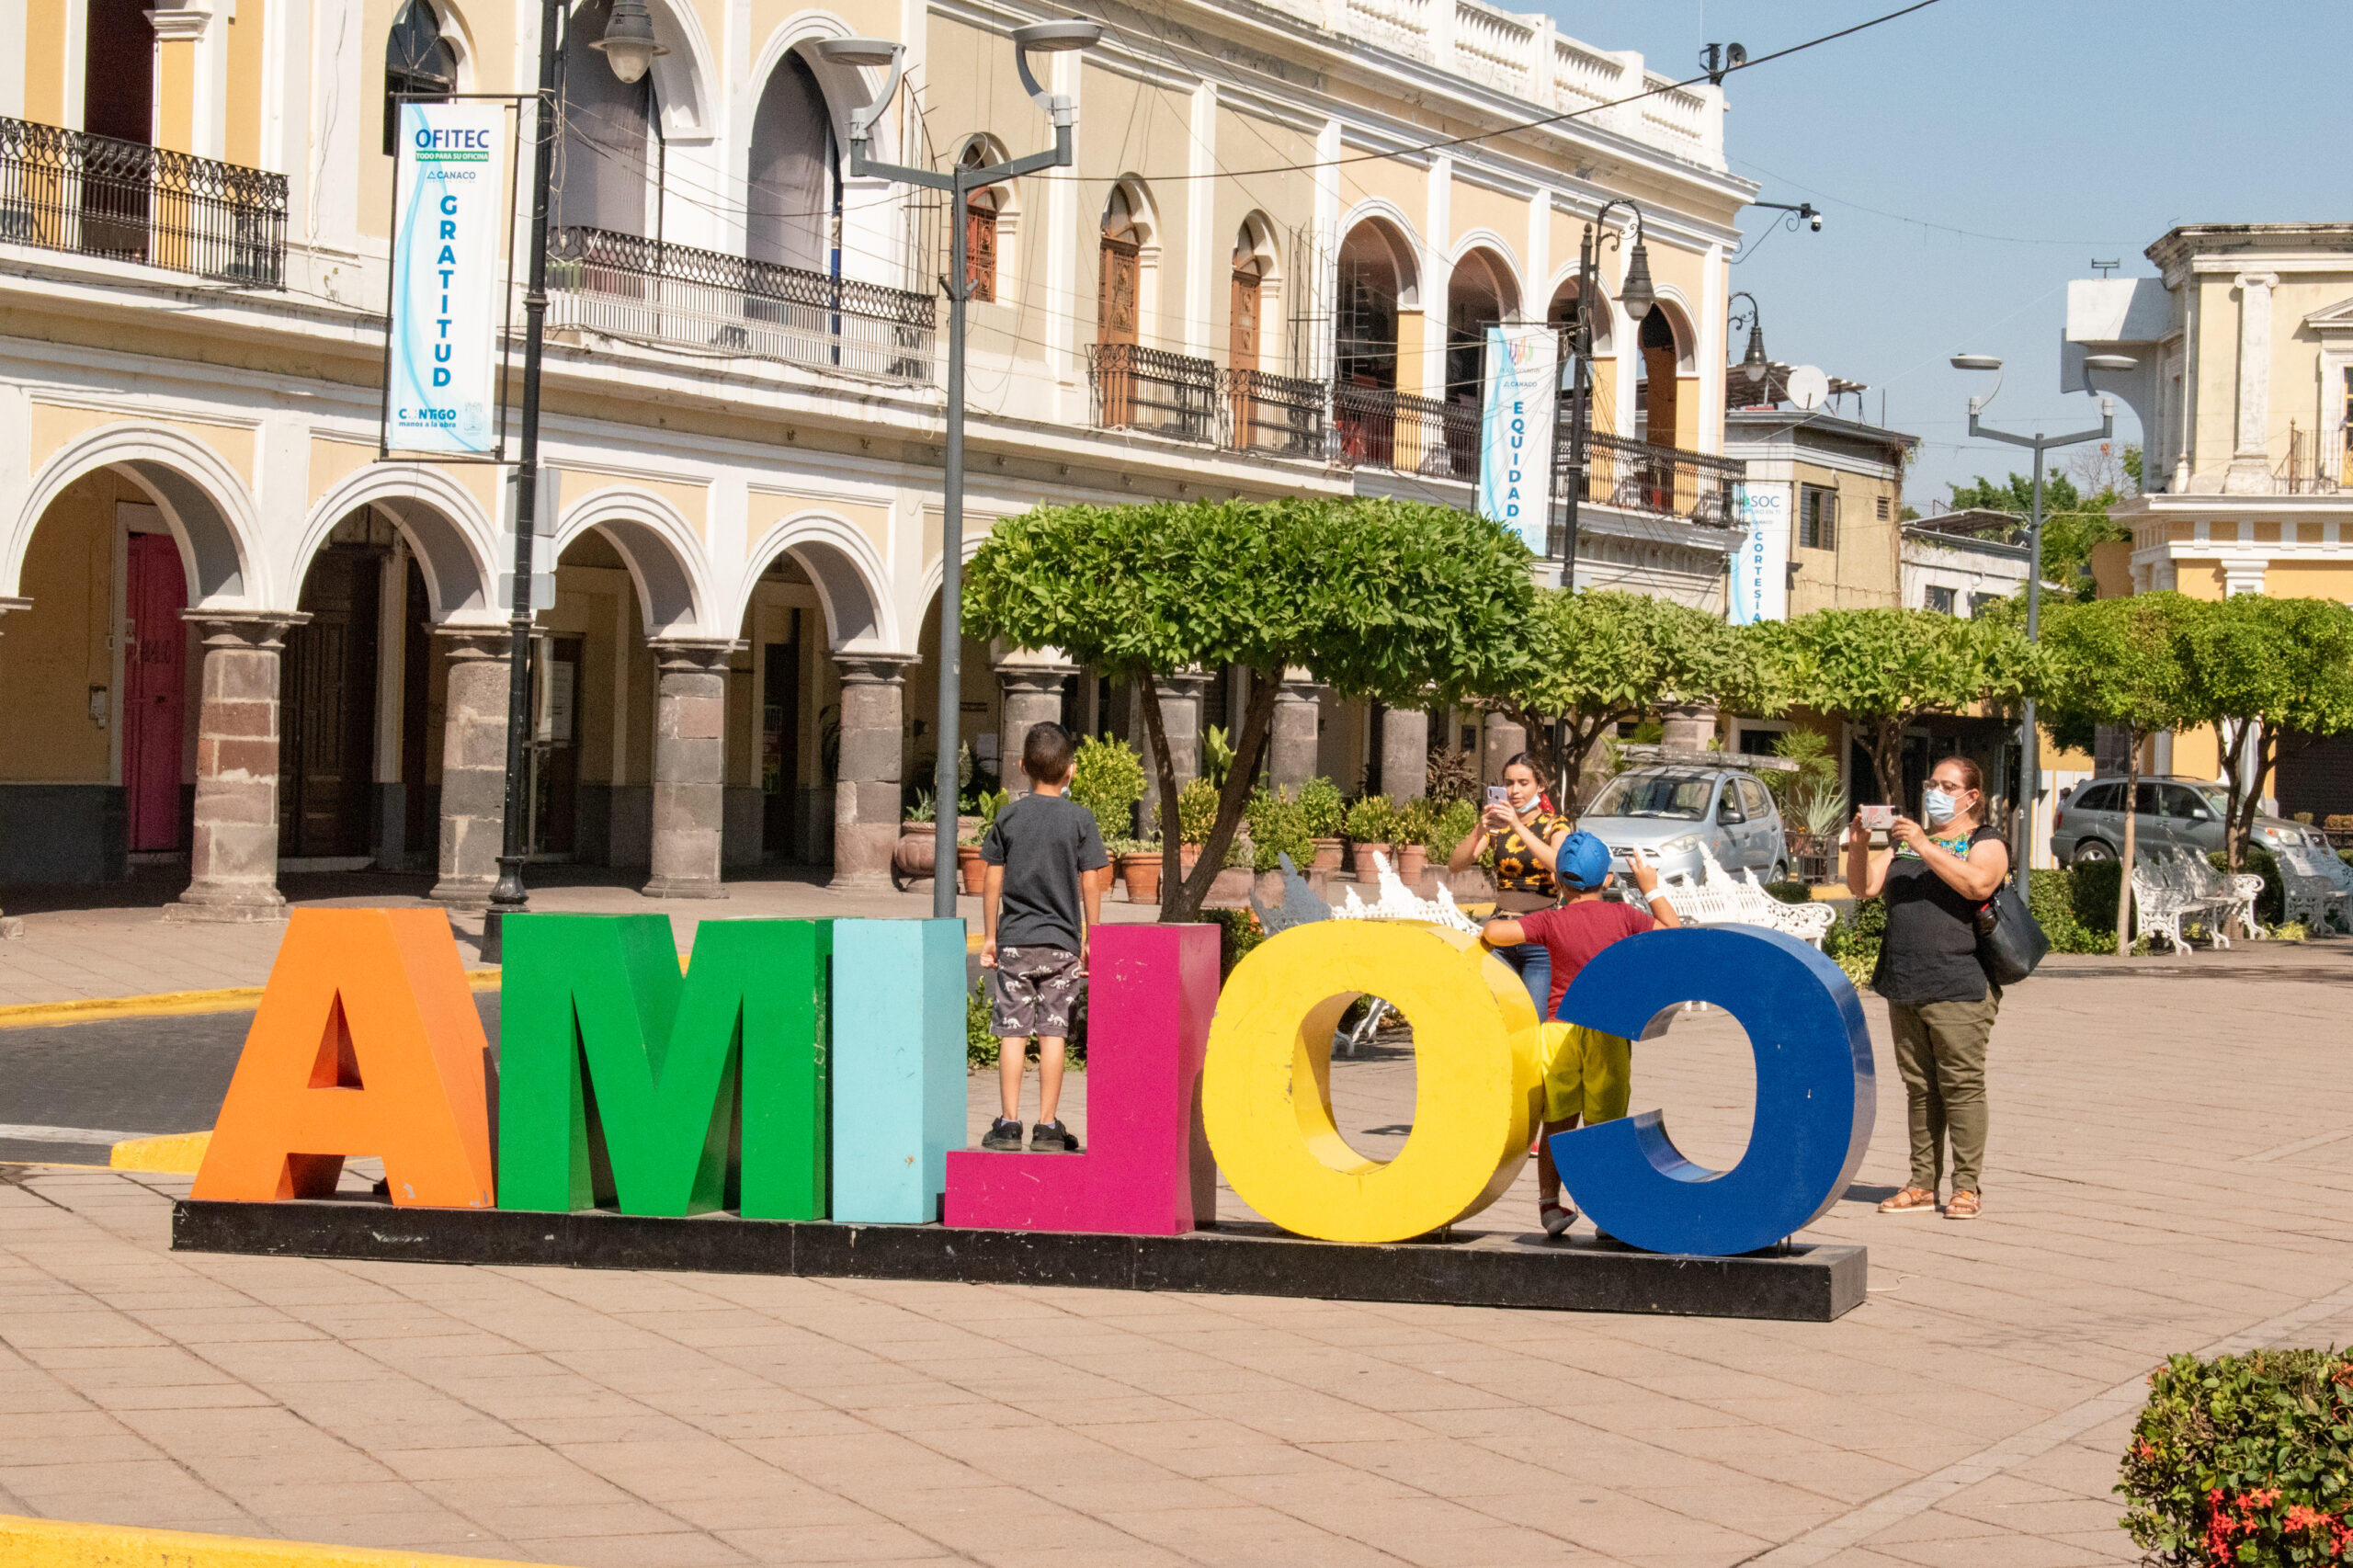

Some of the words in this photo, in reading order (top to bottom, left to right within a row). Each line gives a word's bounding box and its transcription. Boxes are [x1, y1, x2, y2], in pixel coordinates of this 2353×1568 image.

[415, 129, 490, 149] OFITEC
[437, 171, 476, 179] CANACO
[433, 195, 458, 387] GRATITUD
[1506, 402, 1525, 517] EQUIDAD
